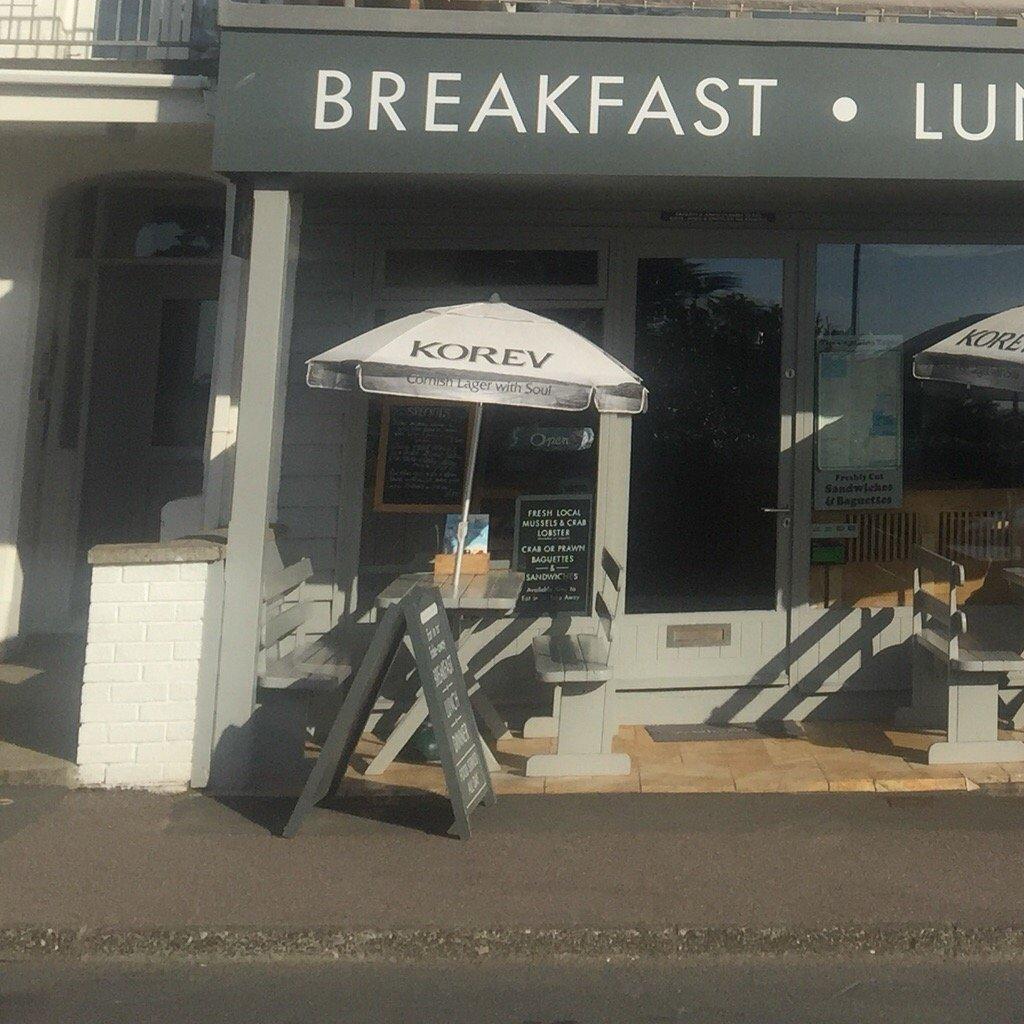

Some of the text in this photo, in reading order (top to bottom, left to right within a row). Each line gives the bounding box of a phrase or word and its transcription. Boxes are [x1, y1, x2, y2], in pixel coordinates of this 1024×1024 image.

[314, 69, 778, 138] BREAKFAST
[410, 340, 554, 369] KOREV
[406, 373, 552, 396] Cornish Lager with Soul
[529, 432, 569, 449] Open
[527, 509, 581, 517] FRESH LOCAL
[522, 520, 557, 528] MUSSELS
[521, 545, 542, 553] CRAB
[557, 544, 586, 552] PRAWN
[531, 555, 574, 564] BAGUETTES
[526, 573, 579, 581] SANDWICS
